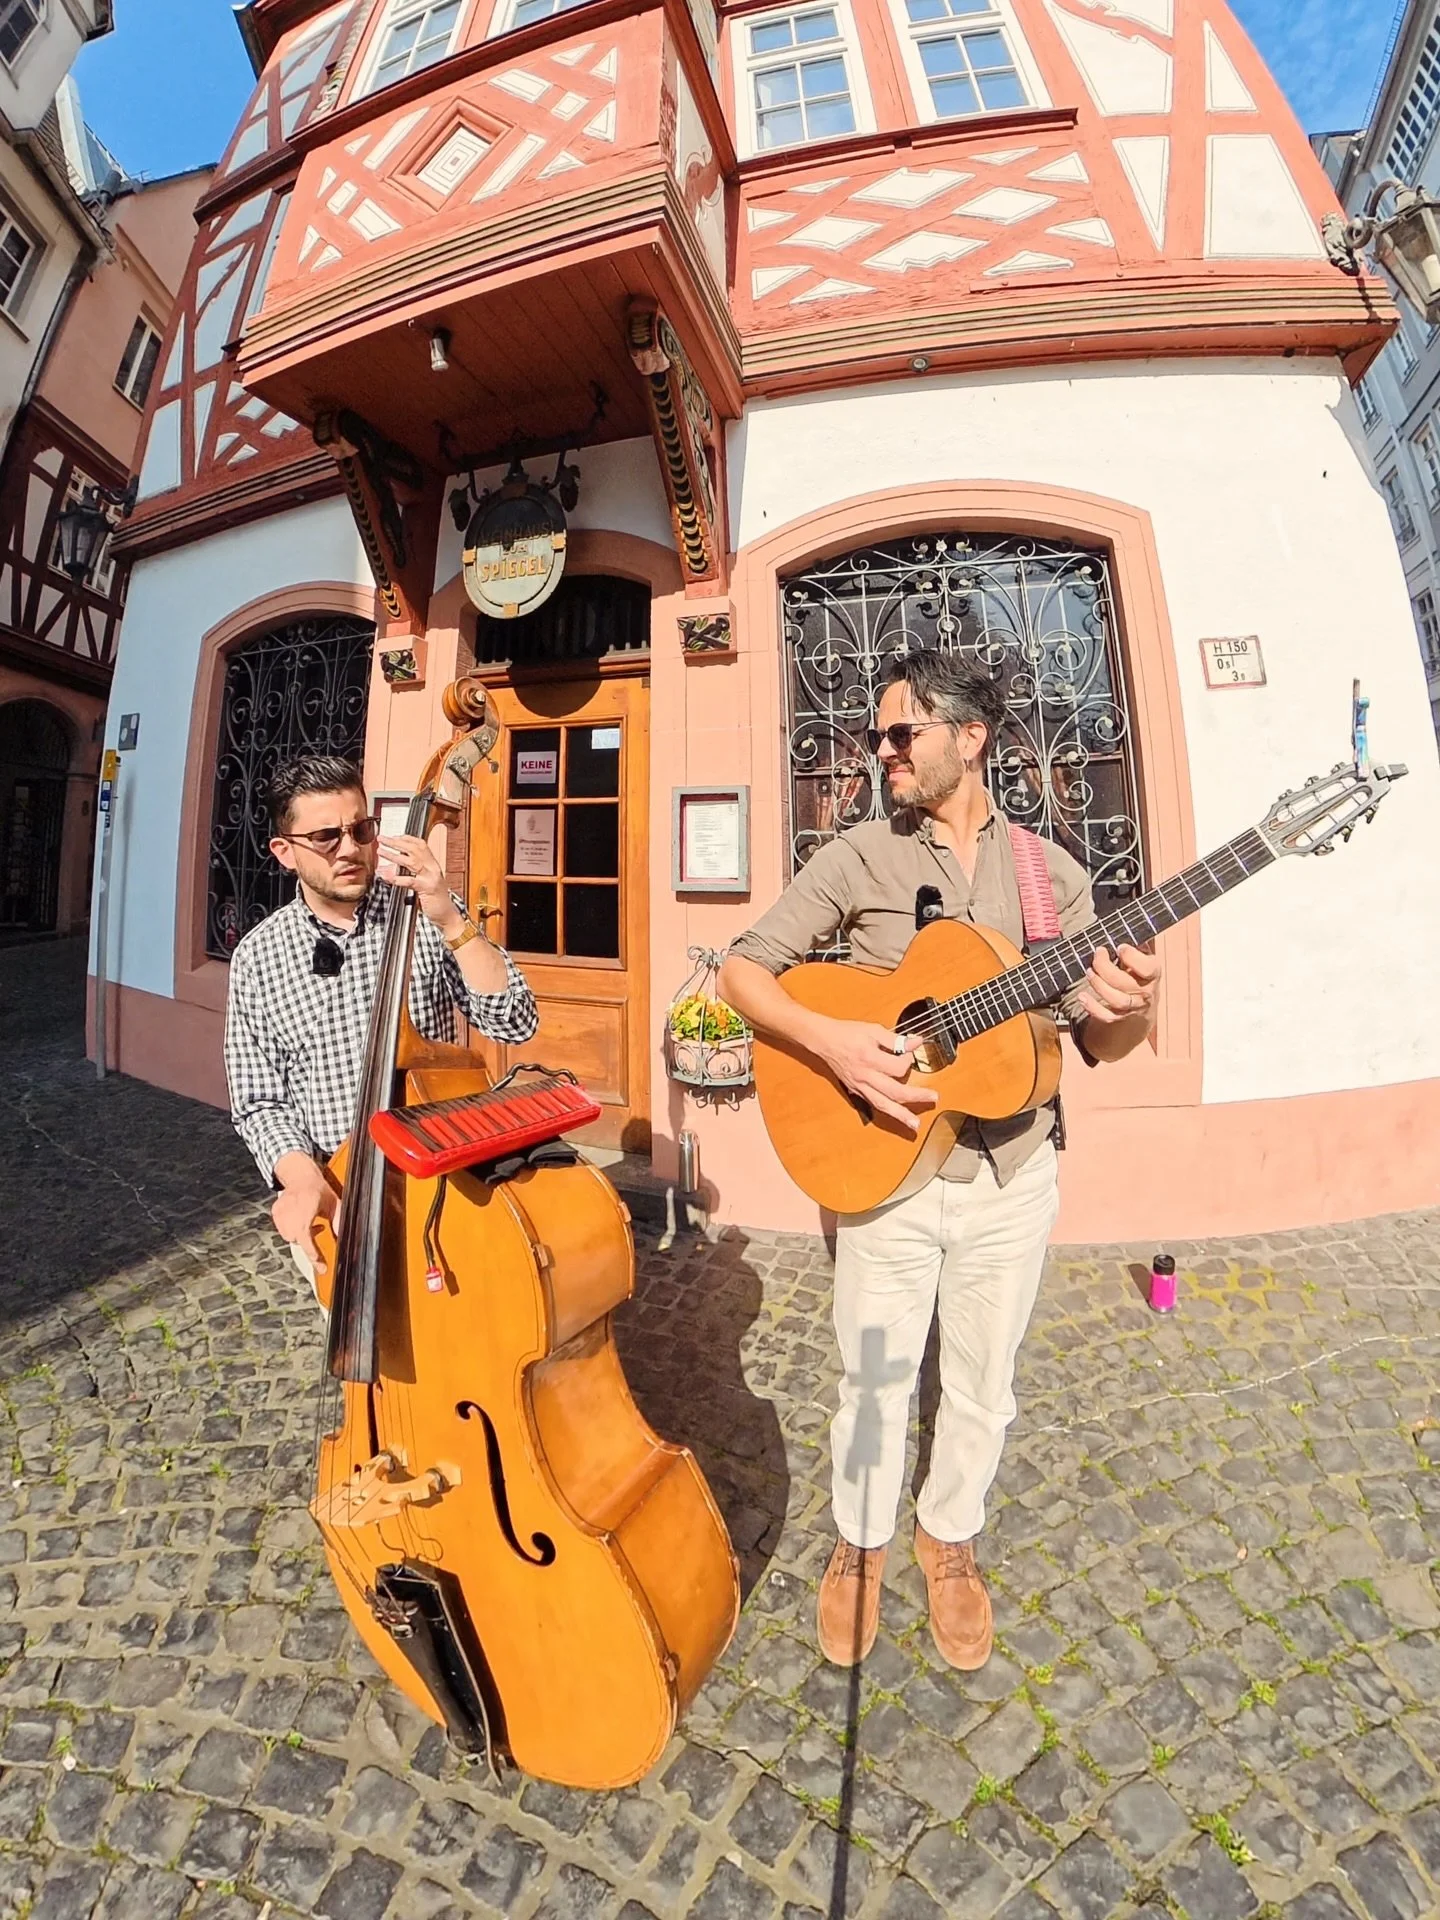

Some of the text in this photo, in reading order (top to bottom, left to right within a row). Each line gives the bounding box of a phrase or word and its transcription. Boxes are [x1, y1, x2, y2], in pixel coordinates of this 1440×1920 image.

[481, 556, 547, 583] SPIEGEL
[1213, 640, 1248, 654] H 150
[521, 760, 553, 769] KEINE
